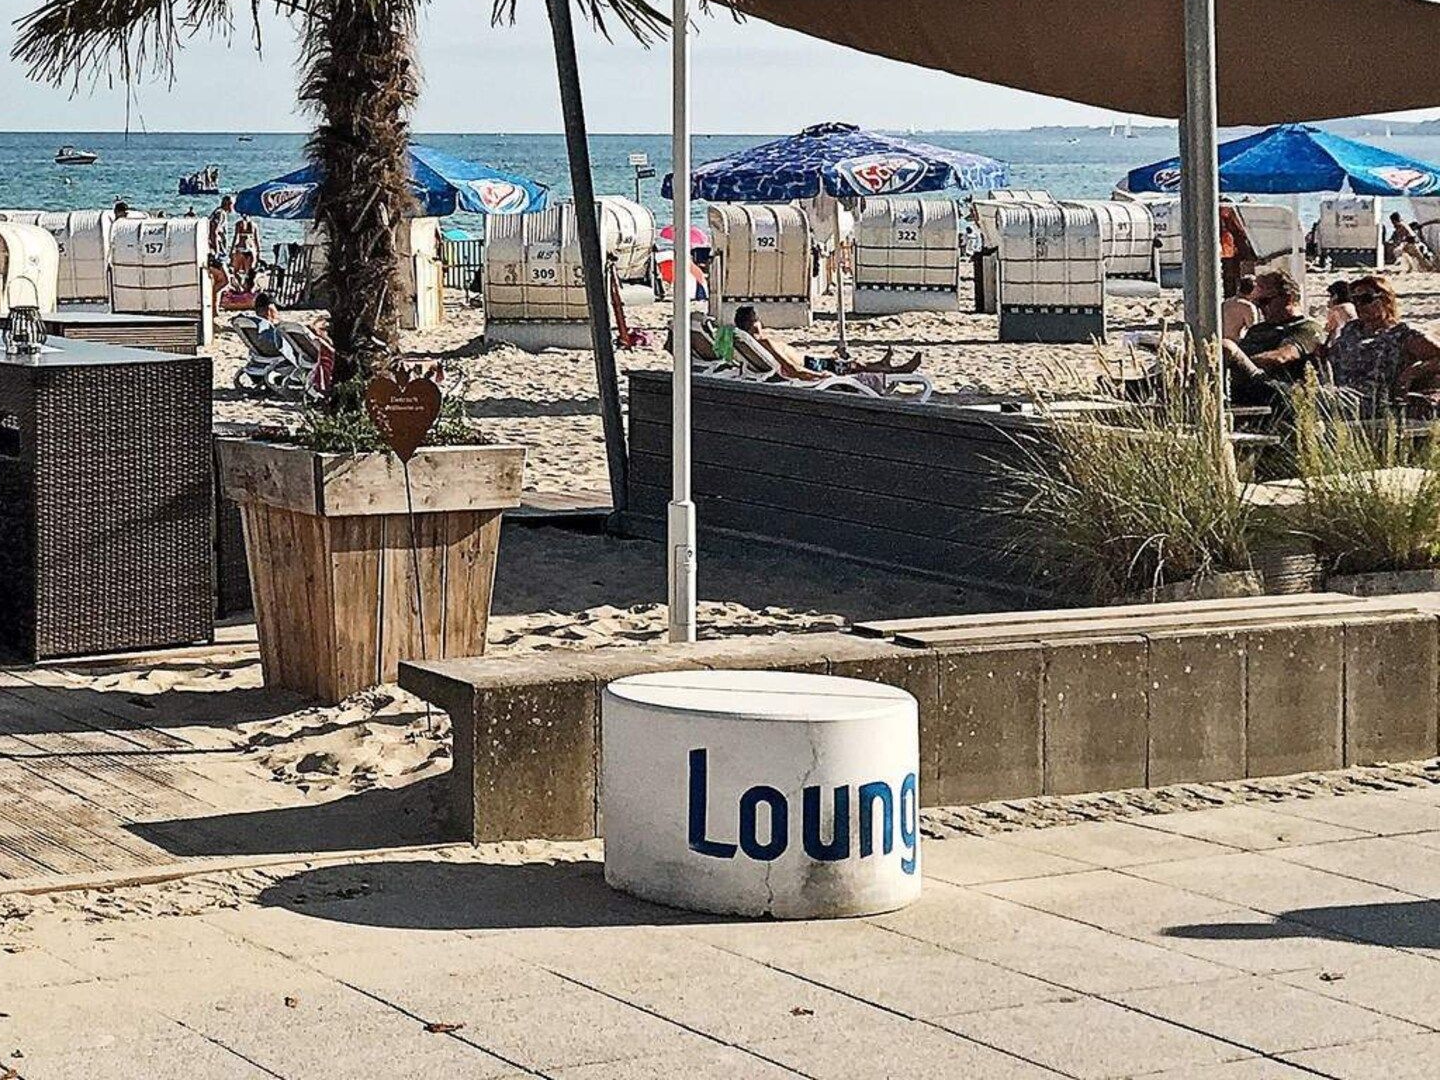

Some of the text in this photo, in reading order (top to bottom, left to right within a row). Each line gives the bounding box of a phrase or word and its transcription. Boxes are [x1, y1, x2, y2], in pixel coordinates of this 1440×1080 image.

[897, 230, 917, 241] 322
[144, 242, 164, 254] 157
[757, 237, 776, 247] 192
[532, 268, 556, 280] 309
[688, 747, 917, 875] Loung
